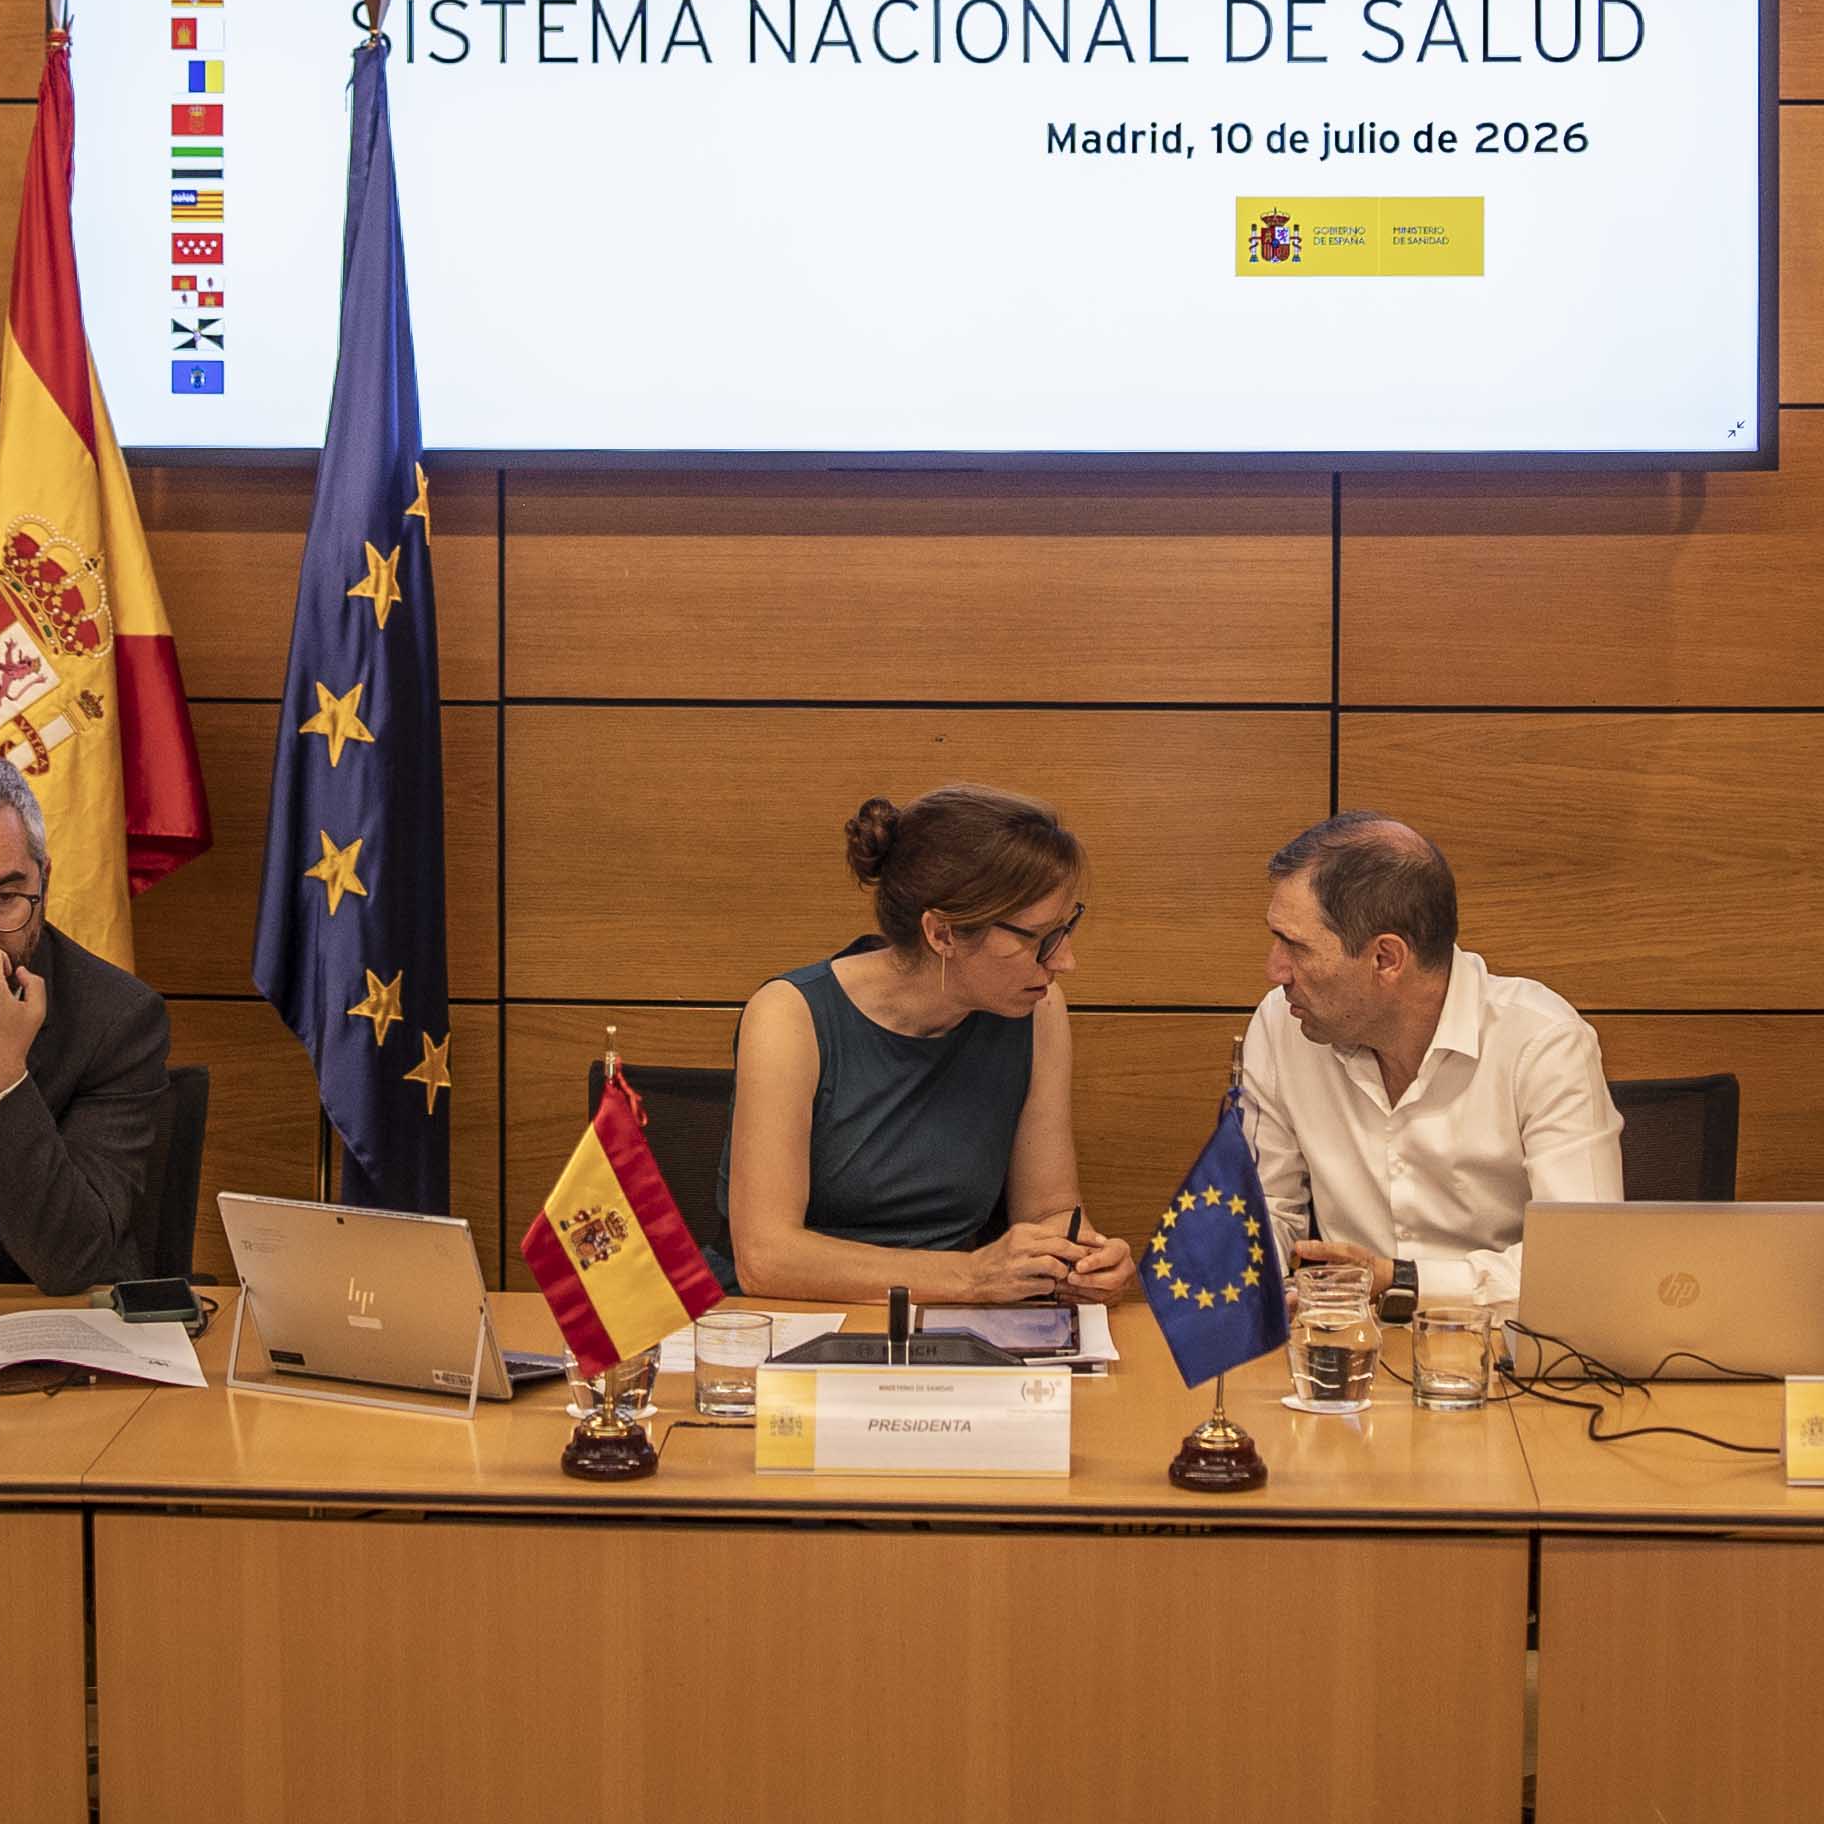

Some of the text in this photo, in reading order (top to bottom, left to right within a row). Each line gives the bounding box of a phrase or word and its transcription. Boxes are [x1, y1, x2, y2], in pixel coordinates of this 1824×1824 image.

[1047, 121, 1590, 162] Madrid, 10 de julio de 2026
[1313, 226, 1366, 236] GOBIERNO
[1393, 226, 1445, 236] MINISTERIO
[1313, 236, 1326, 246] DE
[1393, 236, 1450, 246] DE SANIDAD
[867, 1418, 972, 1433] PRESIDENTA
